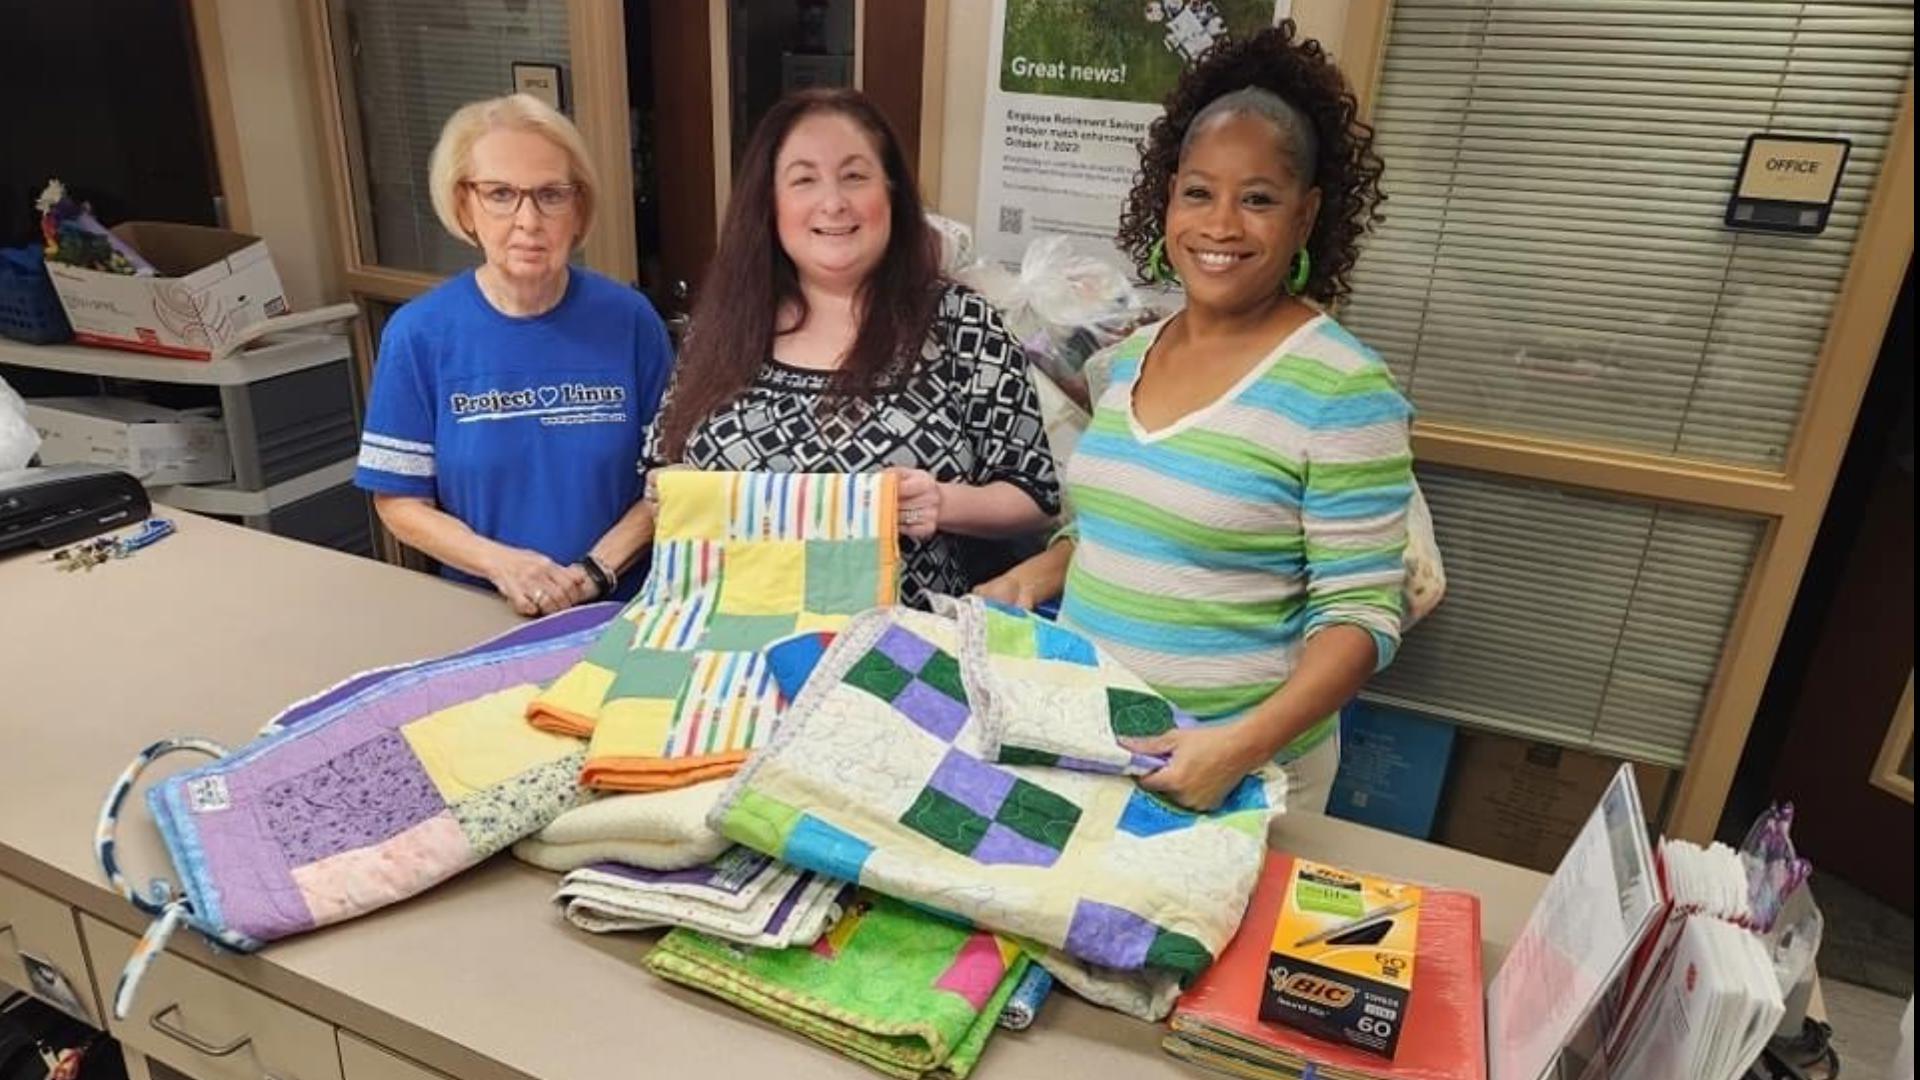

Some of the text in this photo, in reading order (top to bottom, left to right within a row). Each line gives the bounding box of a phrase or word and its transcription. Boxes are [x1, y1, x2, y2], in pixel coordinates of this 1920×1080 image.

[1011, 56, 1126, 84] Great news!
[1765, 157, 1820, 174] OFFICE
[451, 383, 626, 414] Project Linus
[1291, 978, 1347, 1002] BIC
[1357, 1016, 1392, 1038] 60
